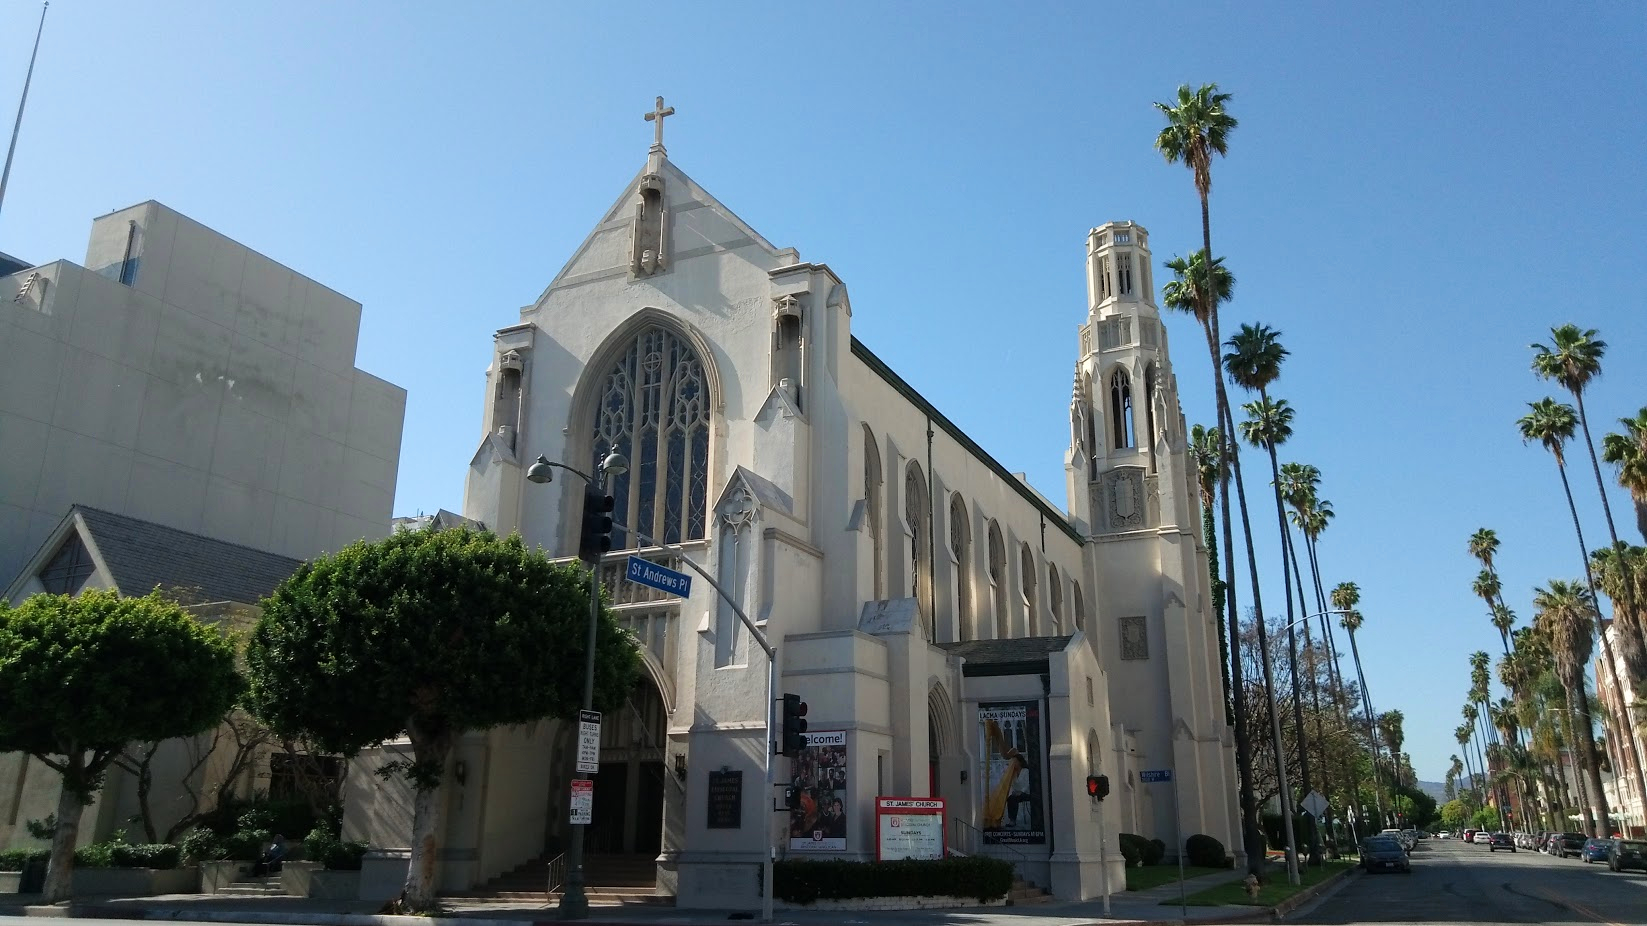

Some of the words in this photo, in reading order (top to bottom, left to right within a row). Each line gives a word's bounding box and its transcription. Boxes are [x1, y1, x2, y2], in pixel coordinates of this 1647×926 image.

[631, 562, 642, 577] St
[643, 566, 677, 588] Andrews
[679, 578, 688, 592] Pl
[979, 711, 998, 719] LACMA
[1000, 710, 1026, 719] SUNDAYS
[582, 723, 597, 732] BUSES
[583, 737, 595, 746] ONLY
[805, 732, 843, 745] elcome!
